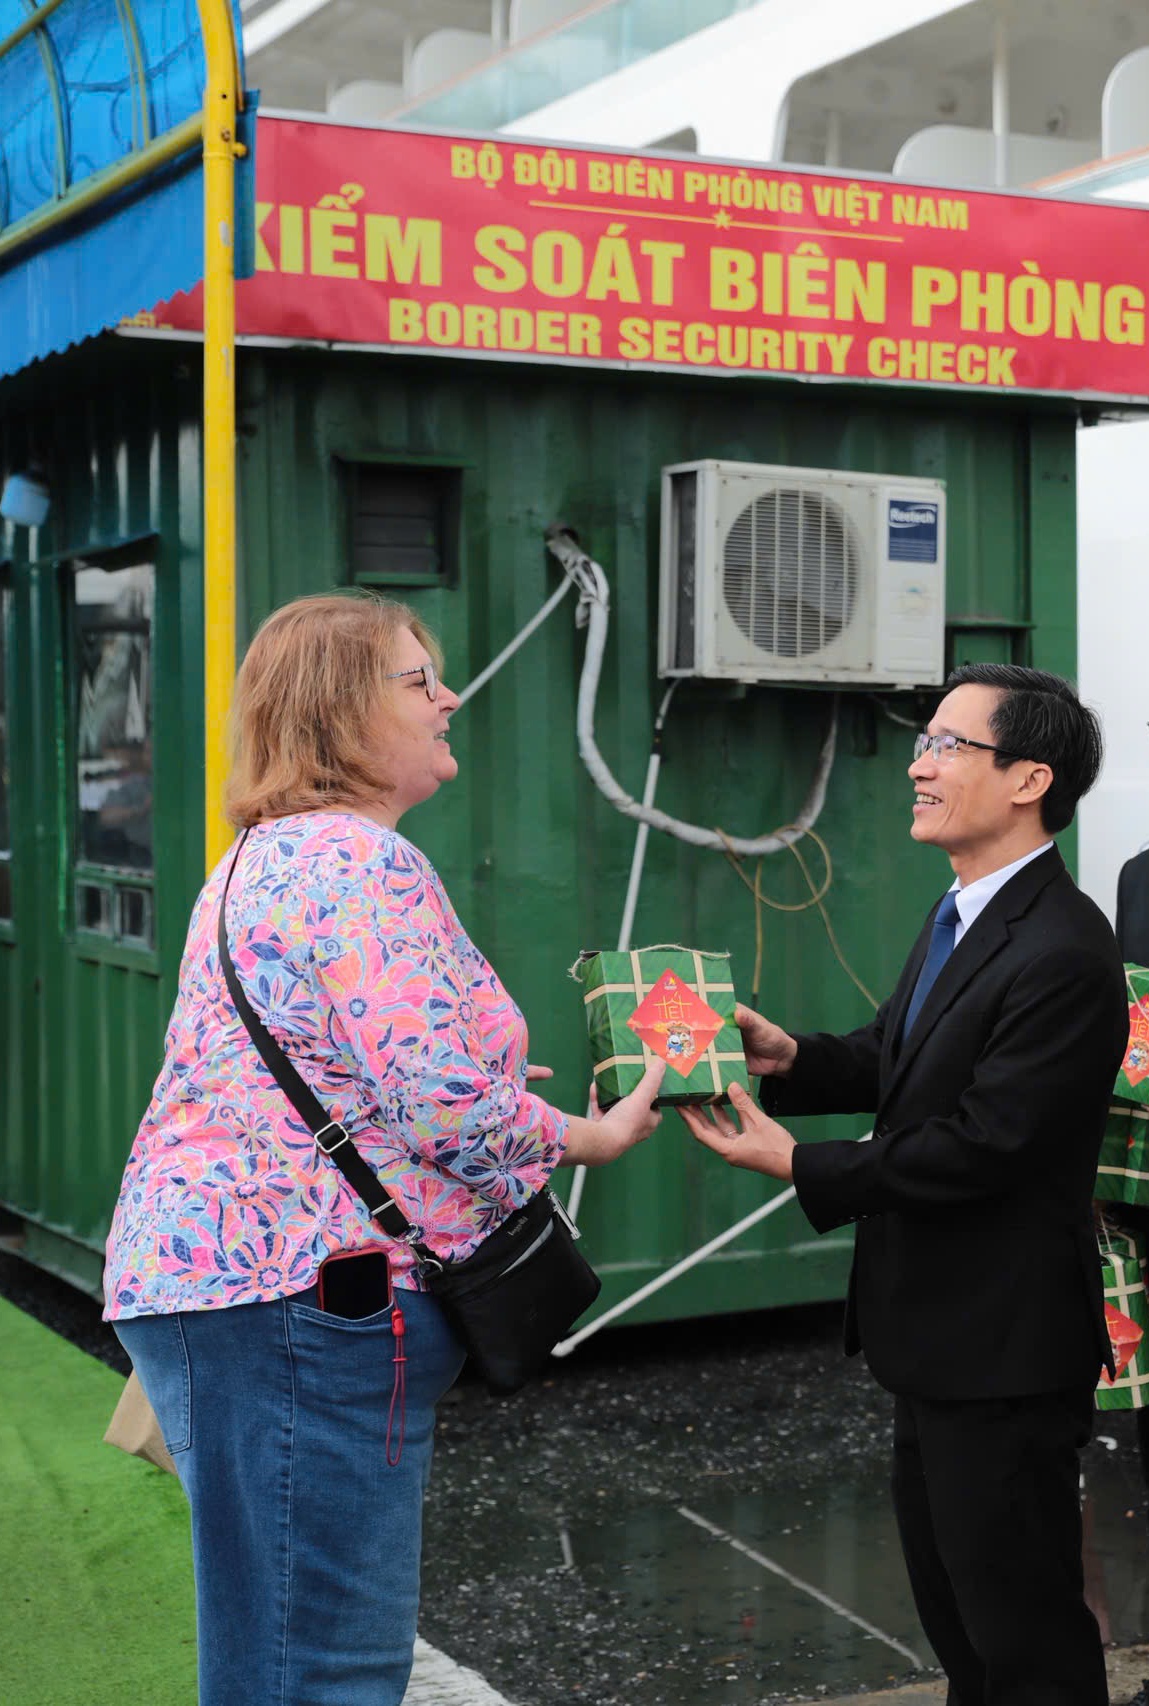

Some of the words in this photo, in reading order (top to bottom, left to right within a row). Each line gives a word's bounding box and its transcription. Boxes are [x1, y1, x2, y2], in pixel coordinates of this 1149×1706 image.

[451, 142, 503, 189] BỘ
[513, 149, 578, 196] ĐỘI
[588, 158, 674, 201] BIÊN
[684, 170, 804, 215] PHÒNG
[812, 184, 884, 226] VIỆT
[893, 194, 969, 231] NAM
[473, 222, 686, 306] SOÁT
[710, 242, 887, 325] BIÊN
[912, 261, 1146, 346] PHÒNG
[389, 299, 602, 356] BORDER
[618, 317, 853, 376] SECURITY
[867, 336, 1018, 387] CHECK
